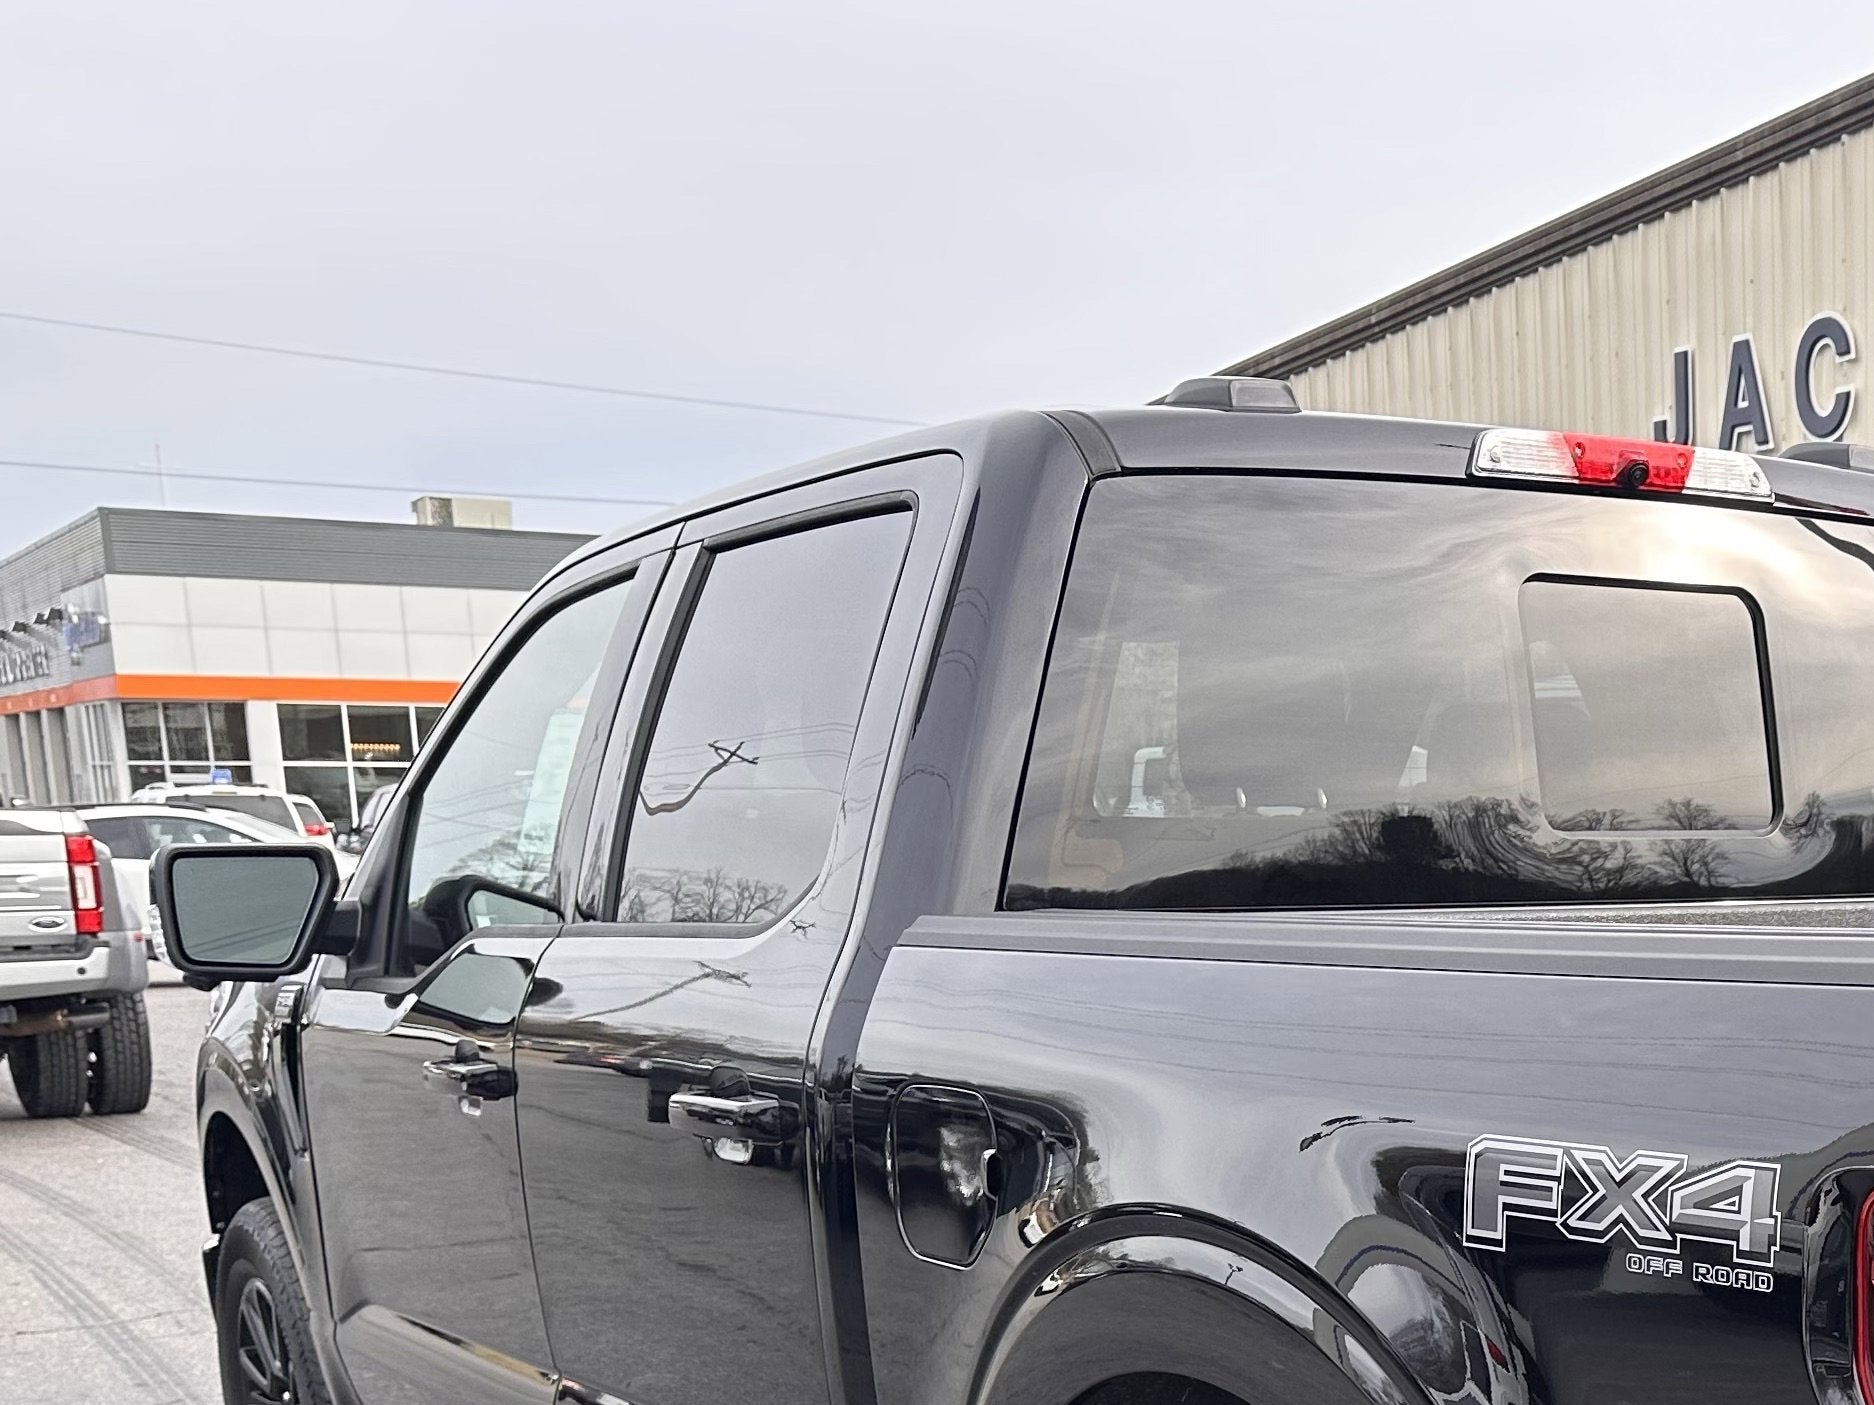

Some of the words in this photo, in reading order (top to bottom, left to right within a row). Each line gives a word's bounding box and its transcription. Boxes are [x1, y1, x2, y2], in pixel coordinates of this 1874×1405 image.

[1463, 1133, 1782, 1267] FX4
[1626, 1253, 1683, 1278] OFF
[1692, 1263, 1774, 1292] ROAD
